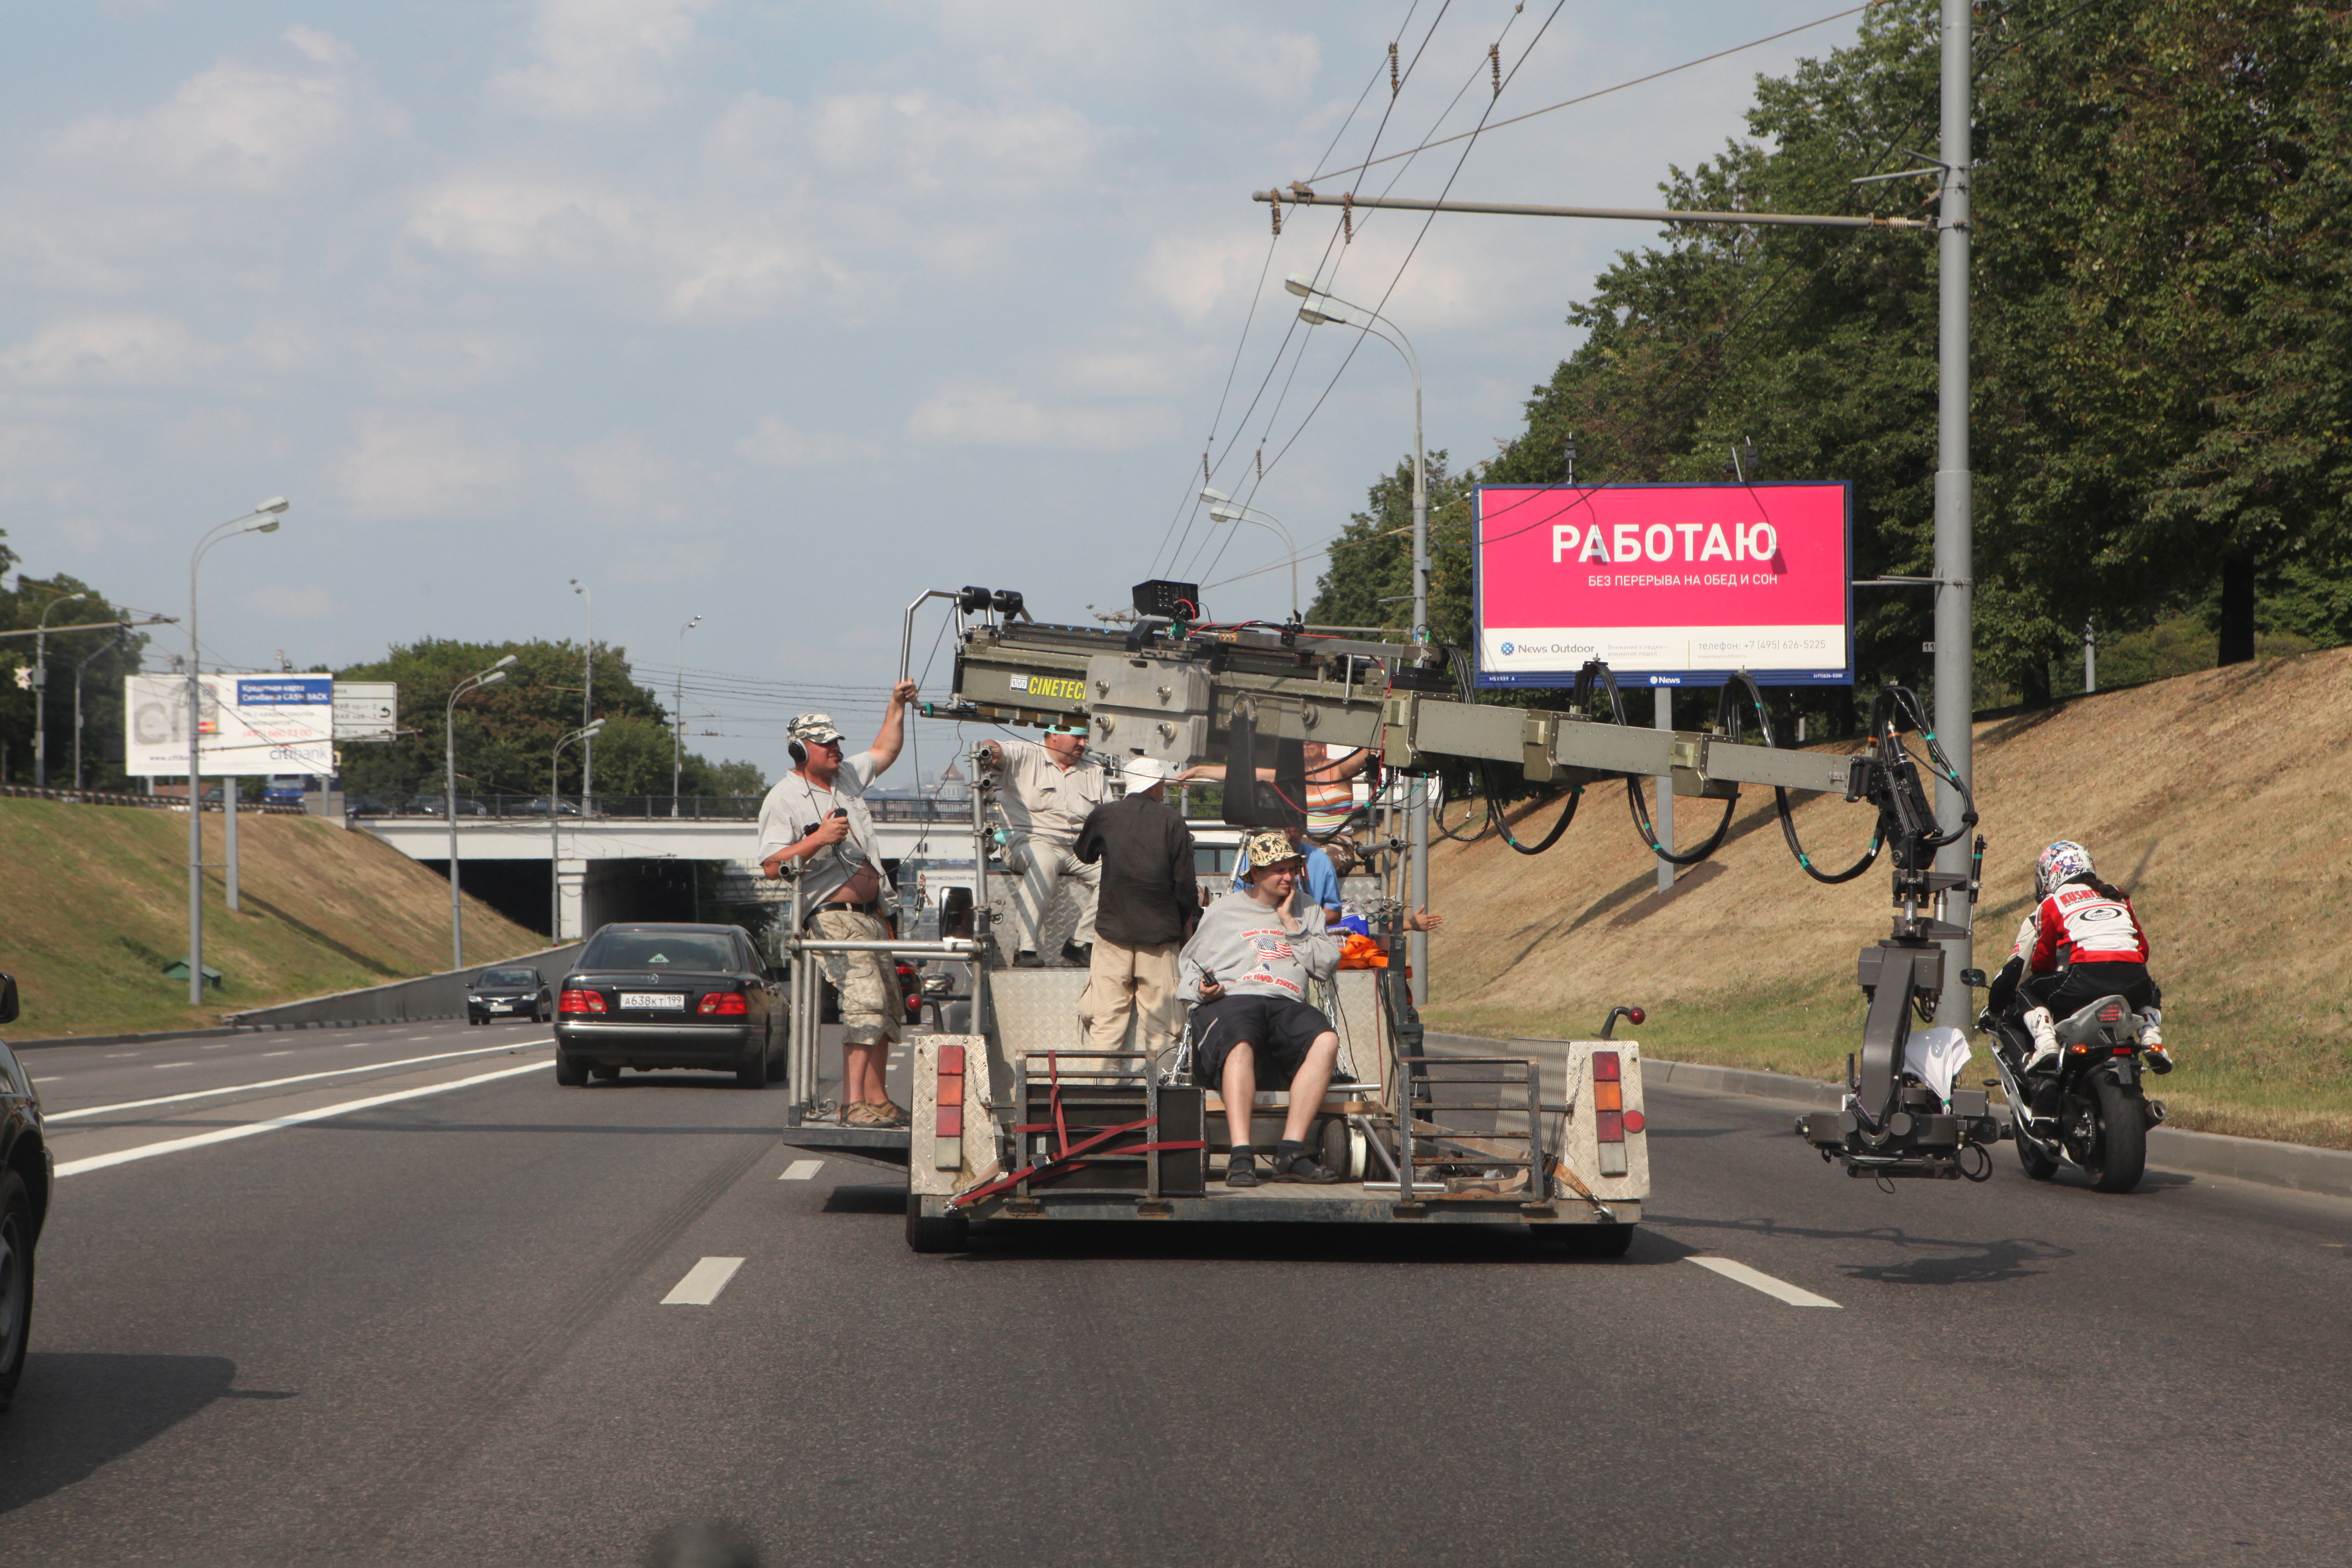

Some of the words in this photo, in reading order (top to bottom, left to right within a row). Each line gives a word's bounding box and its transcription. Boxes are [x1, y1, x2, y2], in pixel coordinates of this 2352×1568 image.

[1553, 523, 1777, 562] РАБОТАЮ
[1589, 576, 1611, 586] БЕЗ
[1615, 575, 1681, 586] ПЕРЕРЫВА
[1684, 575, 1700, 585] НА
[1704, 575, 1737, 586] ОБЕД
[1741, 575, 1749, 584] И
[1753, 574, 1777, 585] СОН
[1518, 645, 1547, 653] News
[1551, 644, 1595, 653] Outdoor
[1698, 641, 1741, 652] телефон:
[1744, 641, 1754, 649] +7
[1757, 640, 1780, 650] (495)
[1783, 640, 1826, 649] 626-5225
[270, 747, 328, 760] citibank
[2059, 889, 2101, 905] KUSHIT
[1254, 974, 1274, 983] HARD
[1275, 978, 1300, 994] KNOCKS
